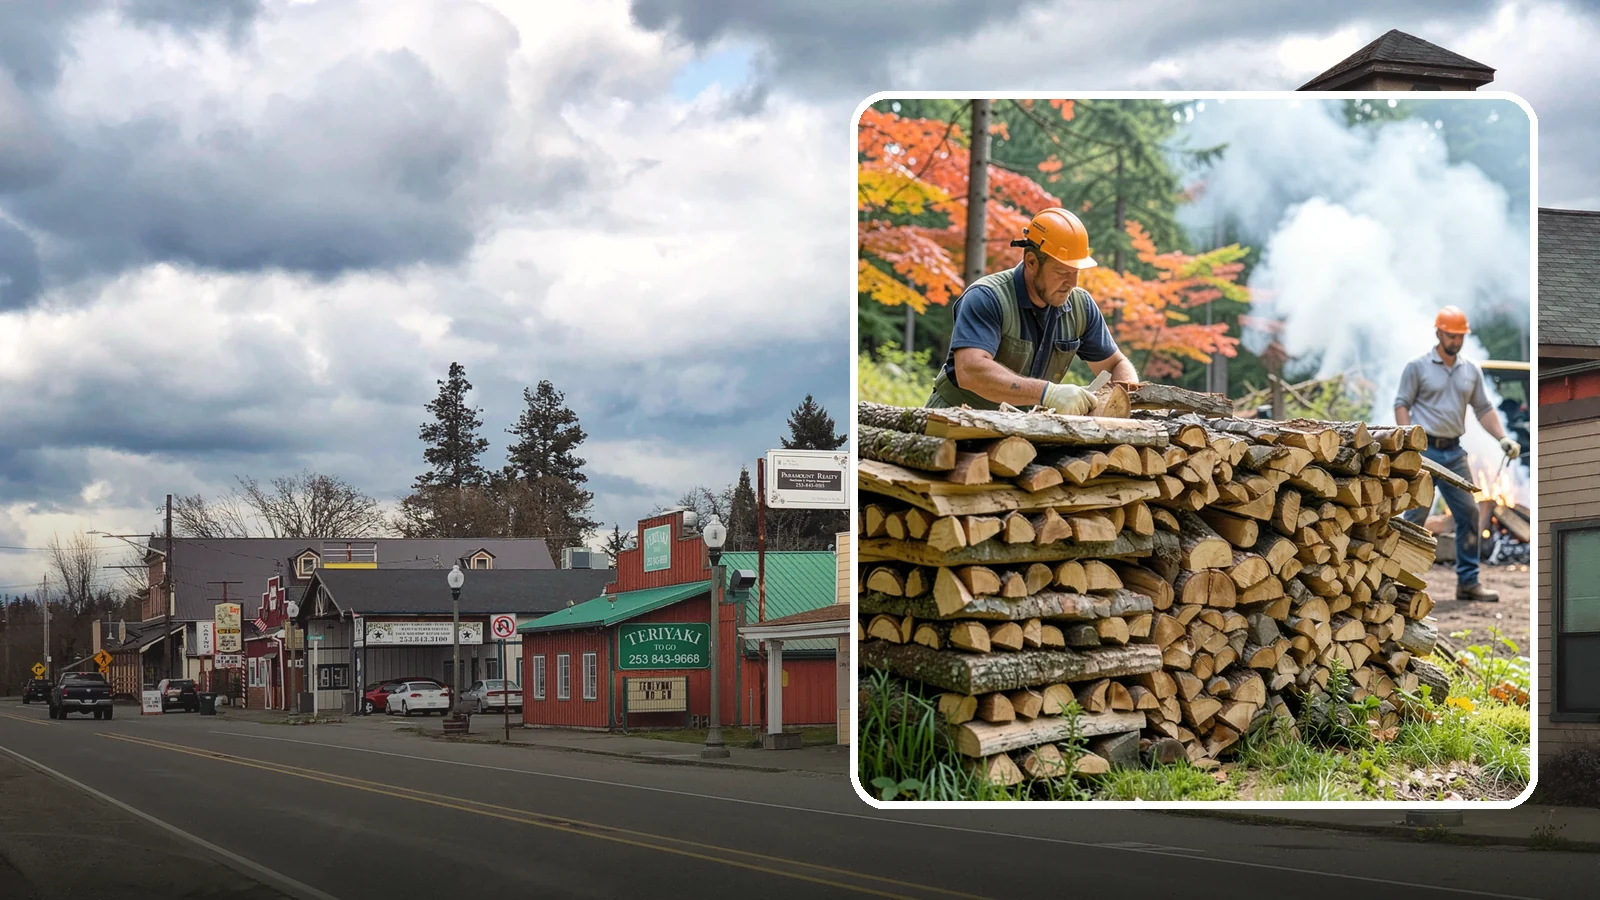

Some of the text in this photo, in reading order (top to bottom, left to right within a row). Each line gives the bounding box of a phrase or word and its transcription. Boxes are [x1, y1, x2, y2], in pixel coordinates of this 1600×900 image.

[624, 627, 702, 646] TERIYAKI
[629, 653, 700, 664] 253 843-9668
